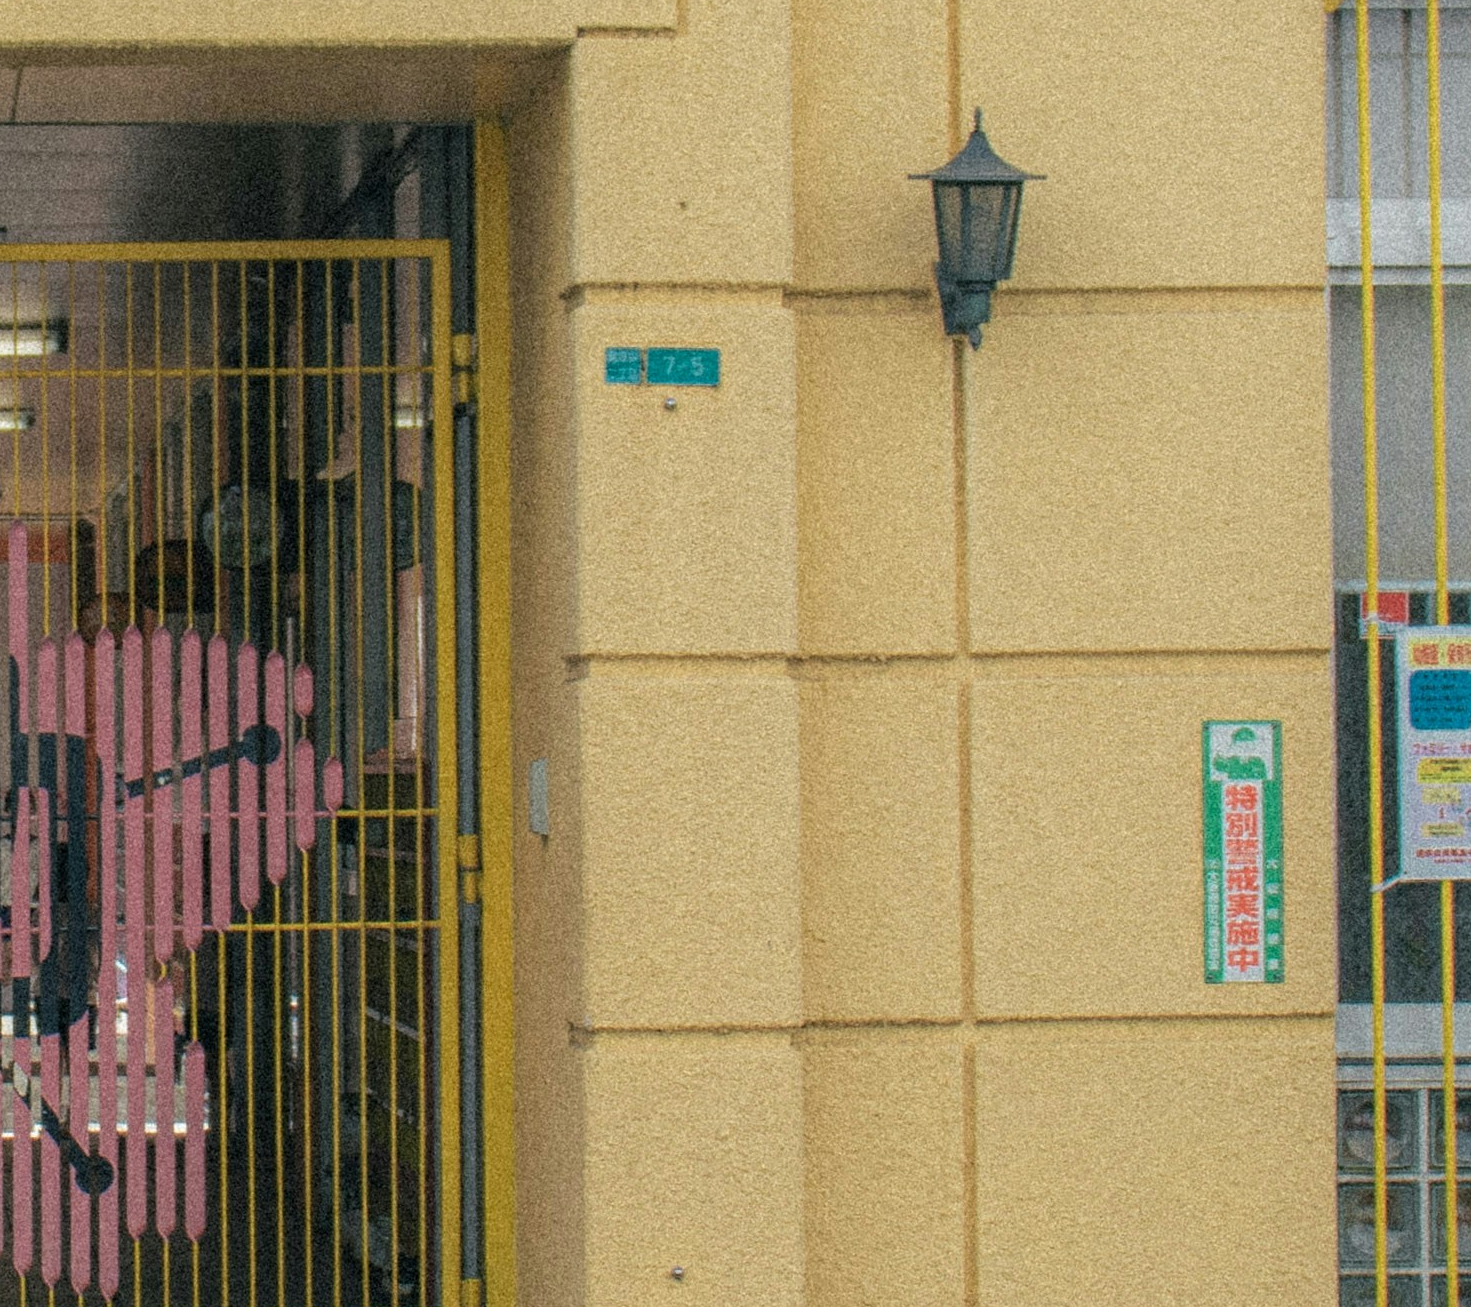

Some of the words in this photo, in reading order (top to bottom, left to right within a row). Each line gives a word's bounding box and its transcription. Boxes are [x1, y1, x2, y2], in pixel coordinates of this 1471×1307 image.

[1224, 783, 1260, 973] 特別警戒実施中
